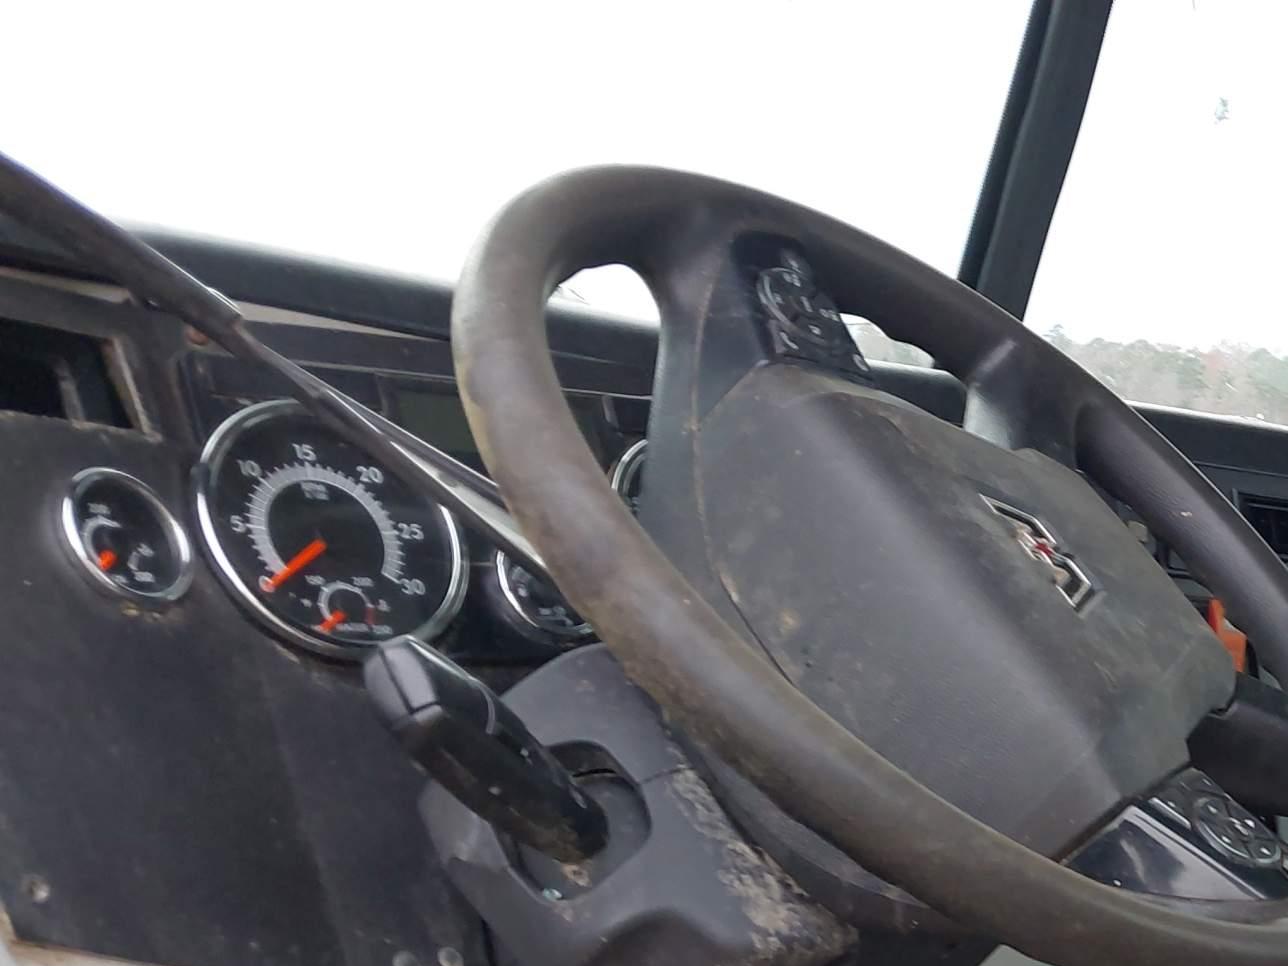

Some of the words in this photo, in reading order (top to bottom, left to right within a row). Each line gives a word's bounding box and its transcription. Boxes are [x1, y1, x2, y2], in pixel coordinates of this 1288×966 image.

[292, 443, 316, 461] 15
[236, 459, 263, 477] 10
[356, 465, 384, 484] 20
[230, 515, 247, 533] 5
[398, 523, 424, 540] 25
[401, 578, 426, 595] 30
